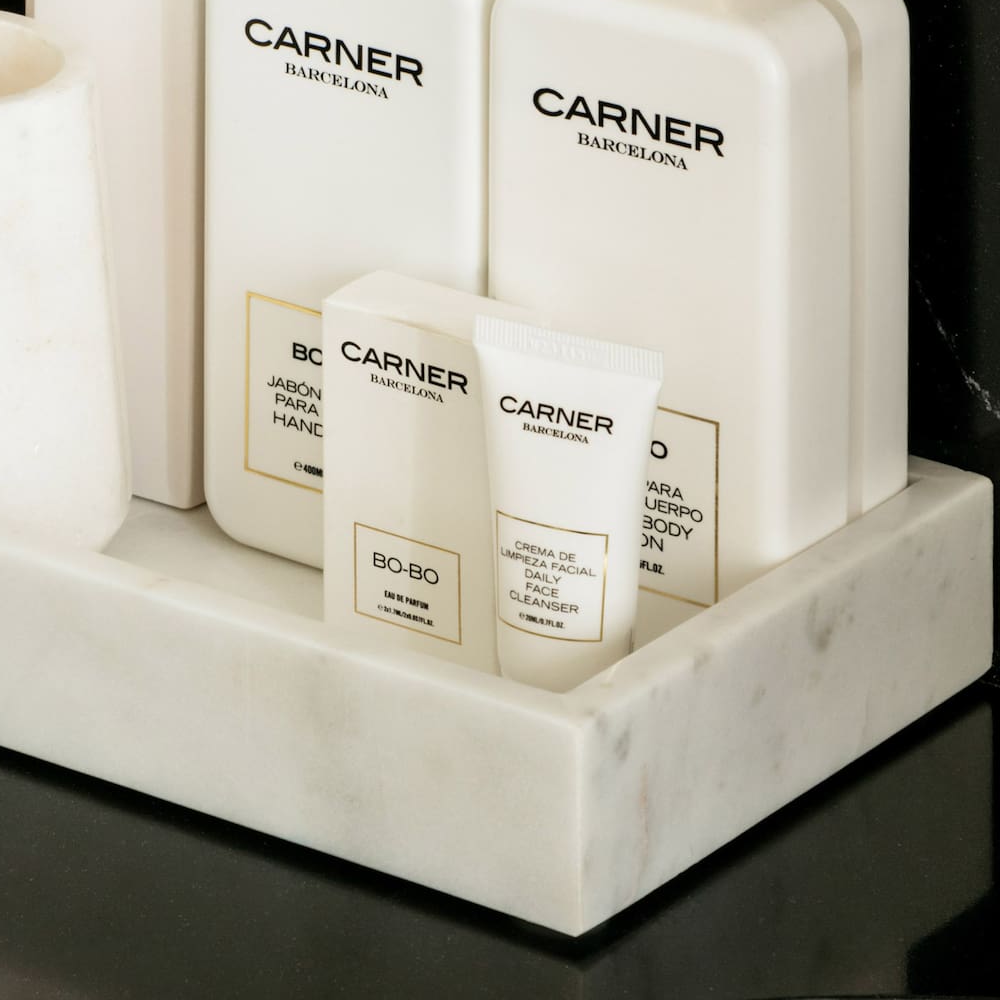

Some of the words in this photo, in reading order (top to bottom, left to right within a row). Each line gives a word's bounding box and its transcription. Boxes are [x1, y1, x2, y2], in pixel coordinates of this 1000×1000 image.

[244, 18, 423, 87] CARNER
[284, 62, 389, 99] BARCELONA
[532, 87, 724, 157] CARNER
[577, 131, 688, 170] BARCELONA
[341, 341, 468, 395] CARNER
[267, 375, 321, 401] JABÓN
[370, 373, 444, 403] BARCELONA
[275, 392, 319, 417] PARA
[499, 395, 614, 435] CARNER
[522, 422, 590, 444] BARCELONA
[646, 480, 684, 501] ARA
[500, 546, 547, 568] LIMPIEZA
[551, 562, 597, 577] FACIAL
[514, 540, 556, 558] CREMA
[559, 551, 576, 562] DE
[373, 552, 439, 585] BO-BO
[524, 568, 562, 584] DAILY
[384, 590, 396, 600] EAU
[396, 593, 404, 603] DE
[405, 596, 429, 610] PARFUM
[509, 589, 580, 614] CLEANSER
[525, 582, 559, 598] FACE
